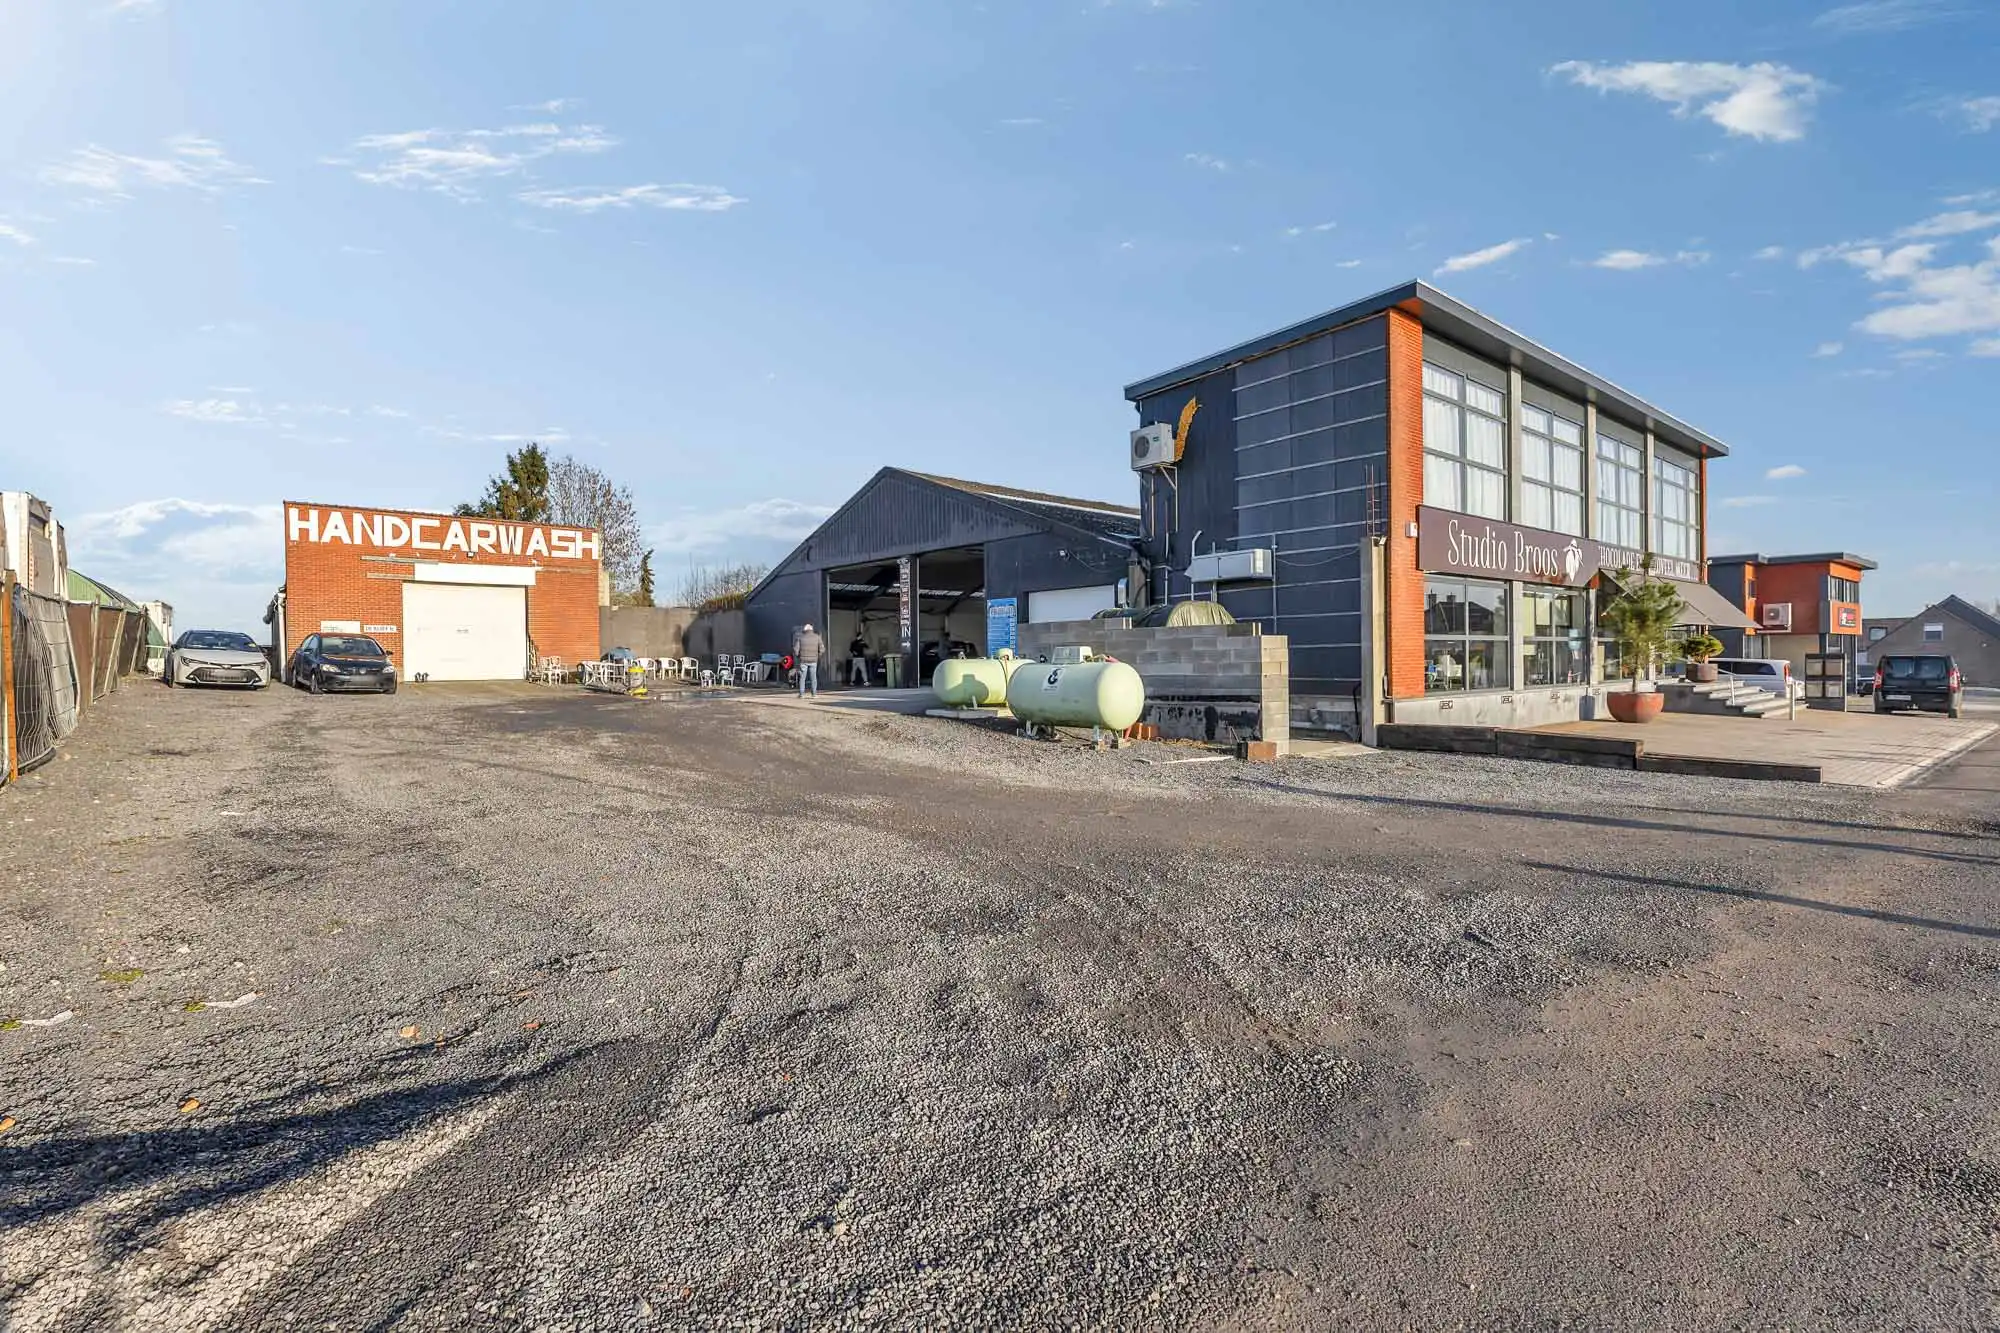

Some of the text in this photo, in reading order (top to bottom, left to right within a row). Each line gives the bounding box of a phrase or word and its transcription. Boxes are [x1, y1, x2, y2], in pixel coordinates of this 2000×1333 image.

[288, 507, 599, 560] HANDCARWASH
[1448, 519, 1559, 577] Studio Broos
[1598, 545, 1635, 571] HOCOLADE
